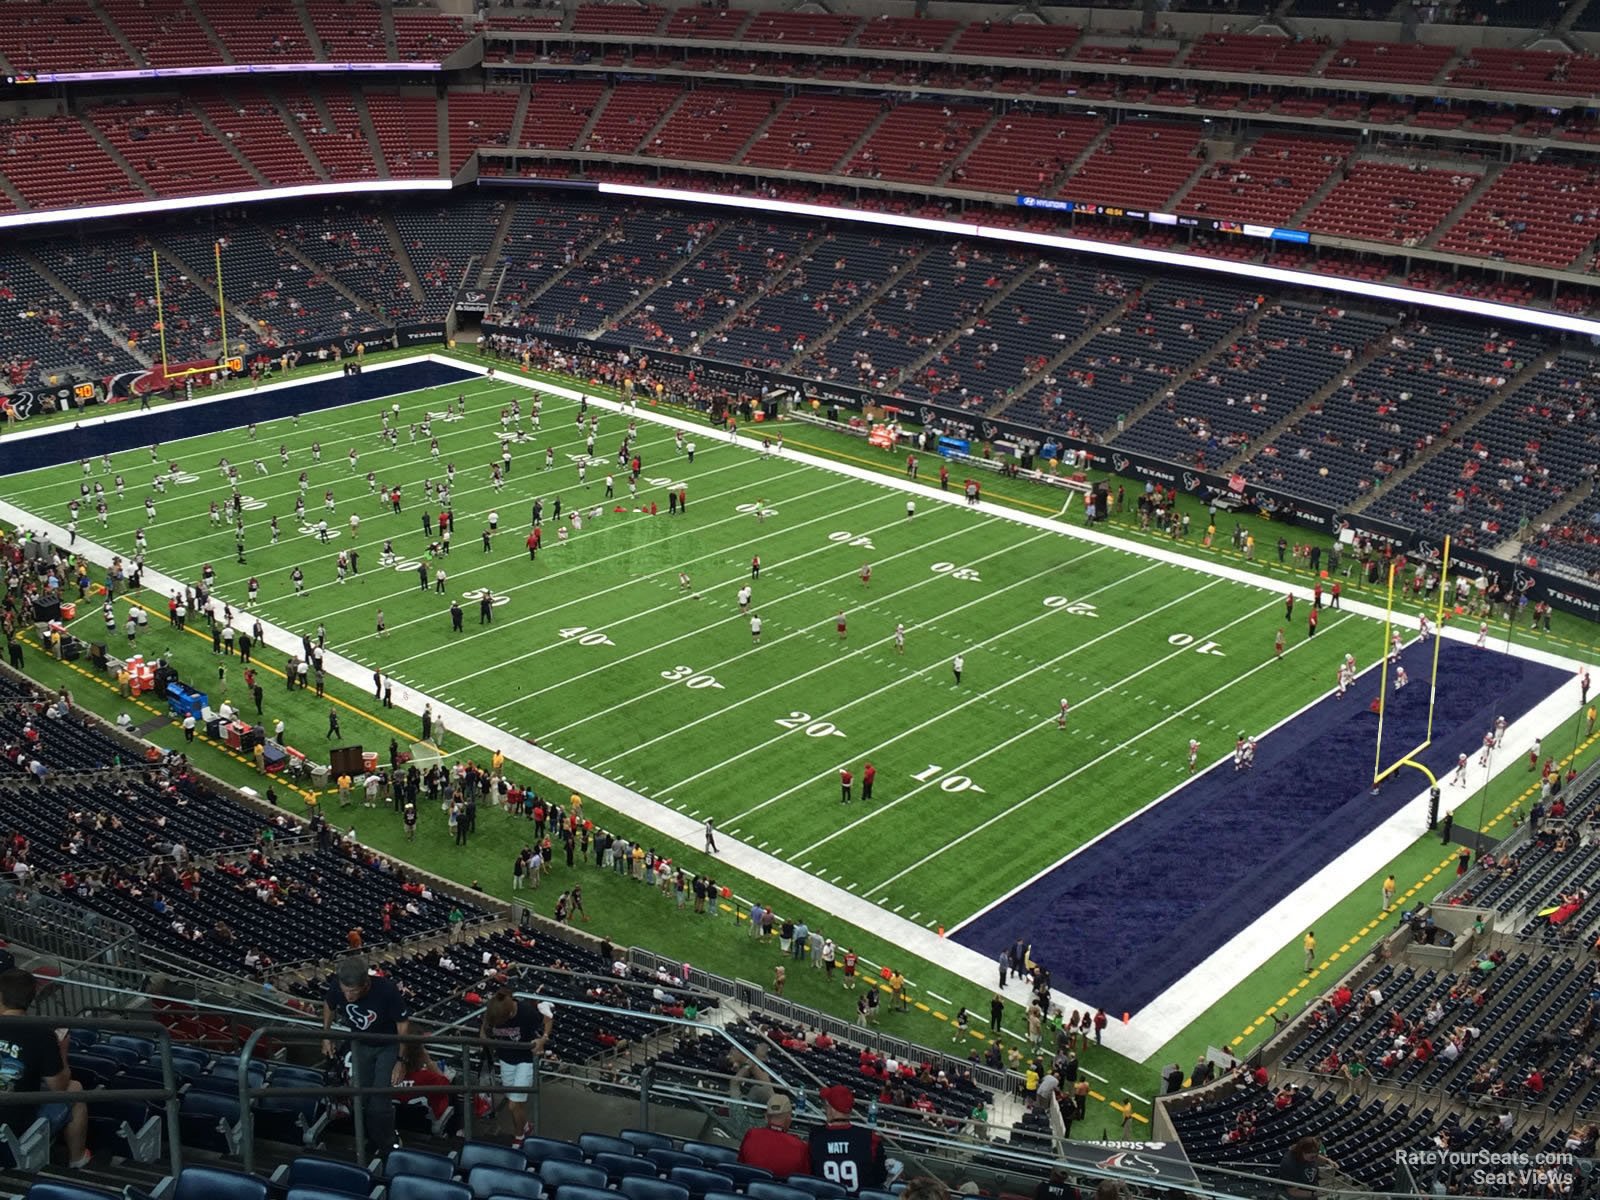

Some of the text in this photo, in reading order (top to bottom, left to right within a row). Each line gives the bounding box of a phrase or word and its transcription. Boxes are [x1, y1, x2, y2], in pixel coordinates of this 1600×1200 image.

[1036, 199, 1067, 209] HYUNDAI
[408, 331, 443, 339] TEXANS
[75, 385, 92, 398] 40
[822, 391, 856, 404] TEXANS
[940, 417, 975, 431] TEXANS
[1135, 465, 1176, 482] TEXANS
[1296, 511, 1325, 524] XANS
[1355, 528, 1403, 547] TEXANS
[930, 562, 980, 579] 30
[1043, 596, 1097, 615] 20
[1547, 588, 1600, 611] TEXANS
[558, 626, 608, 646] 40
[1168, 633, 1222, 654] 10
[661, 665, 716, 689] 30
[774, 711, 836, 737] 20
[910, 764, 973, 792] 10
[827, 1142, 849, 1154] WATT
[823, 1160, 859, 1192] 99
